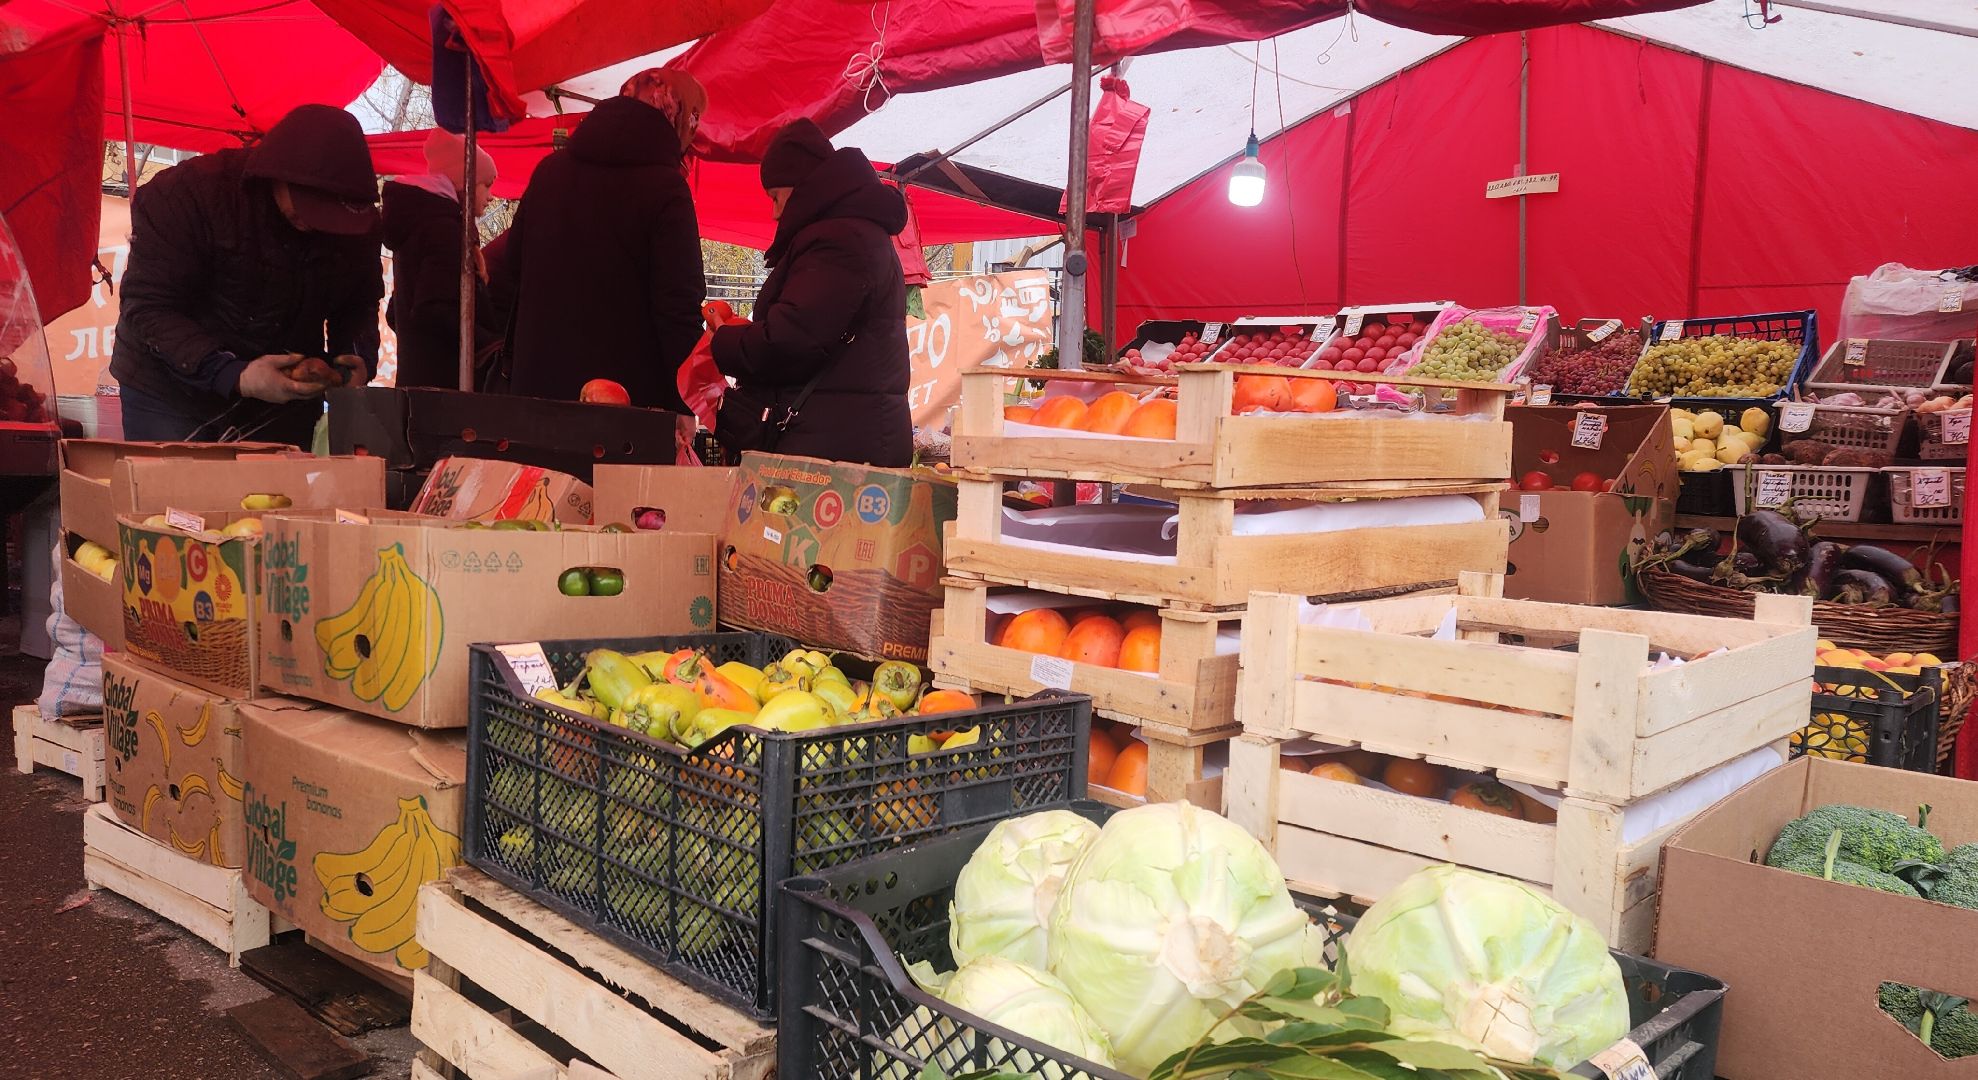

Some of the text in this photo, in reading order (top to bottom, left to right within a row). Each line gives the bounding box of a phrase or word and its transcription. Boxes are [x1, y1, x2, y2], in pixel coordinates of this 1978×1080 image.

[790, 467, 832, 486] Ecuador
[819, 496, 838, 522] C
[858, 494, 888, 516] B3
[190, 550, 205, 575] C
[264, 529, 300, 570] Global
[787, 535, 814, 569] K
[138, 565, 151, 585] Mg
[908, 553, 930, 584] P
[265, 570, 310, 624] Village
[746, 576, 797, 608] PRIMA
[139, 597, 178, 627] PRIMA
[195, 601, 214, 622] B3
[747, 597, 801, 630] DONNA
[882, 641, 929, 661] PREMI
[103, 671, 140, 711] Global
[105, 708, 139, 762] Village
[292, 776, 329, 799] Premium
[243, 781, 287, 842] Global
[306, 795, 343, 819] bananas
[245, 824, 297, 902] Village
